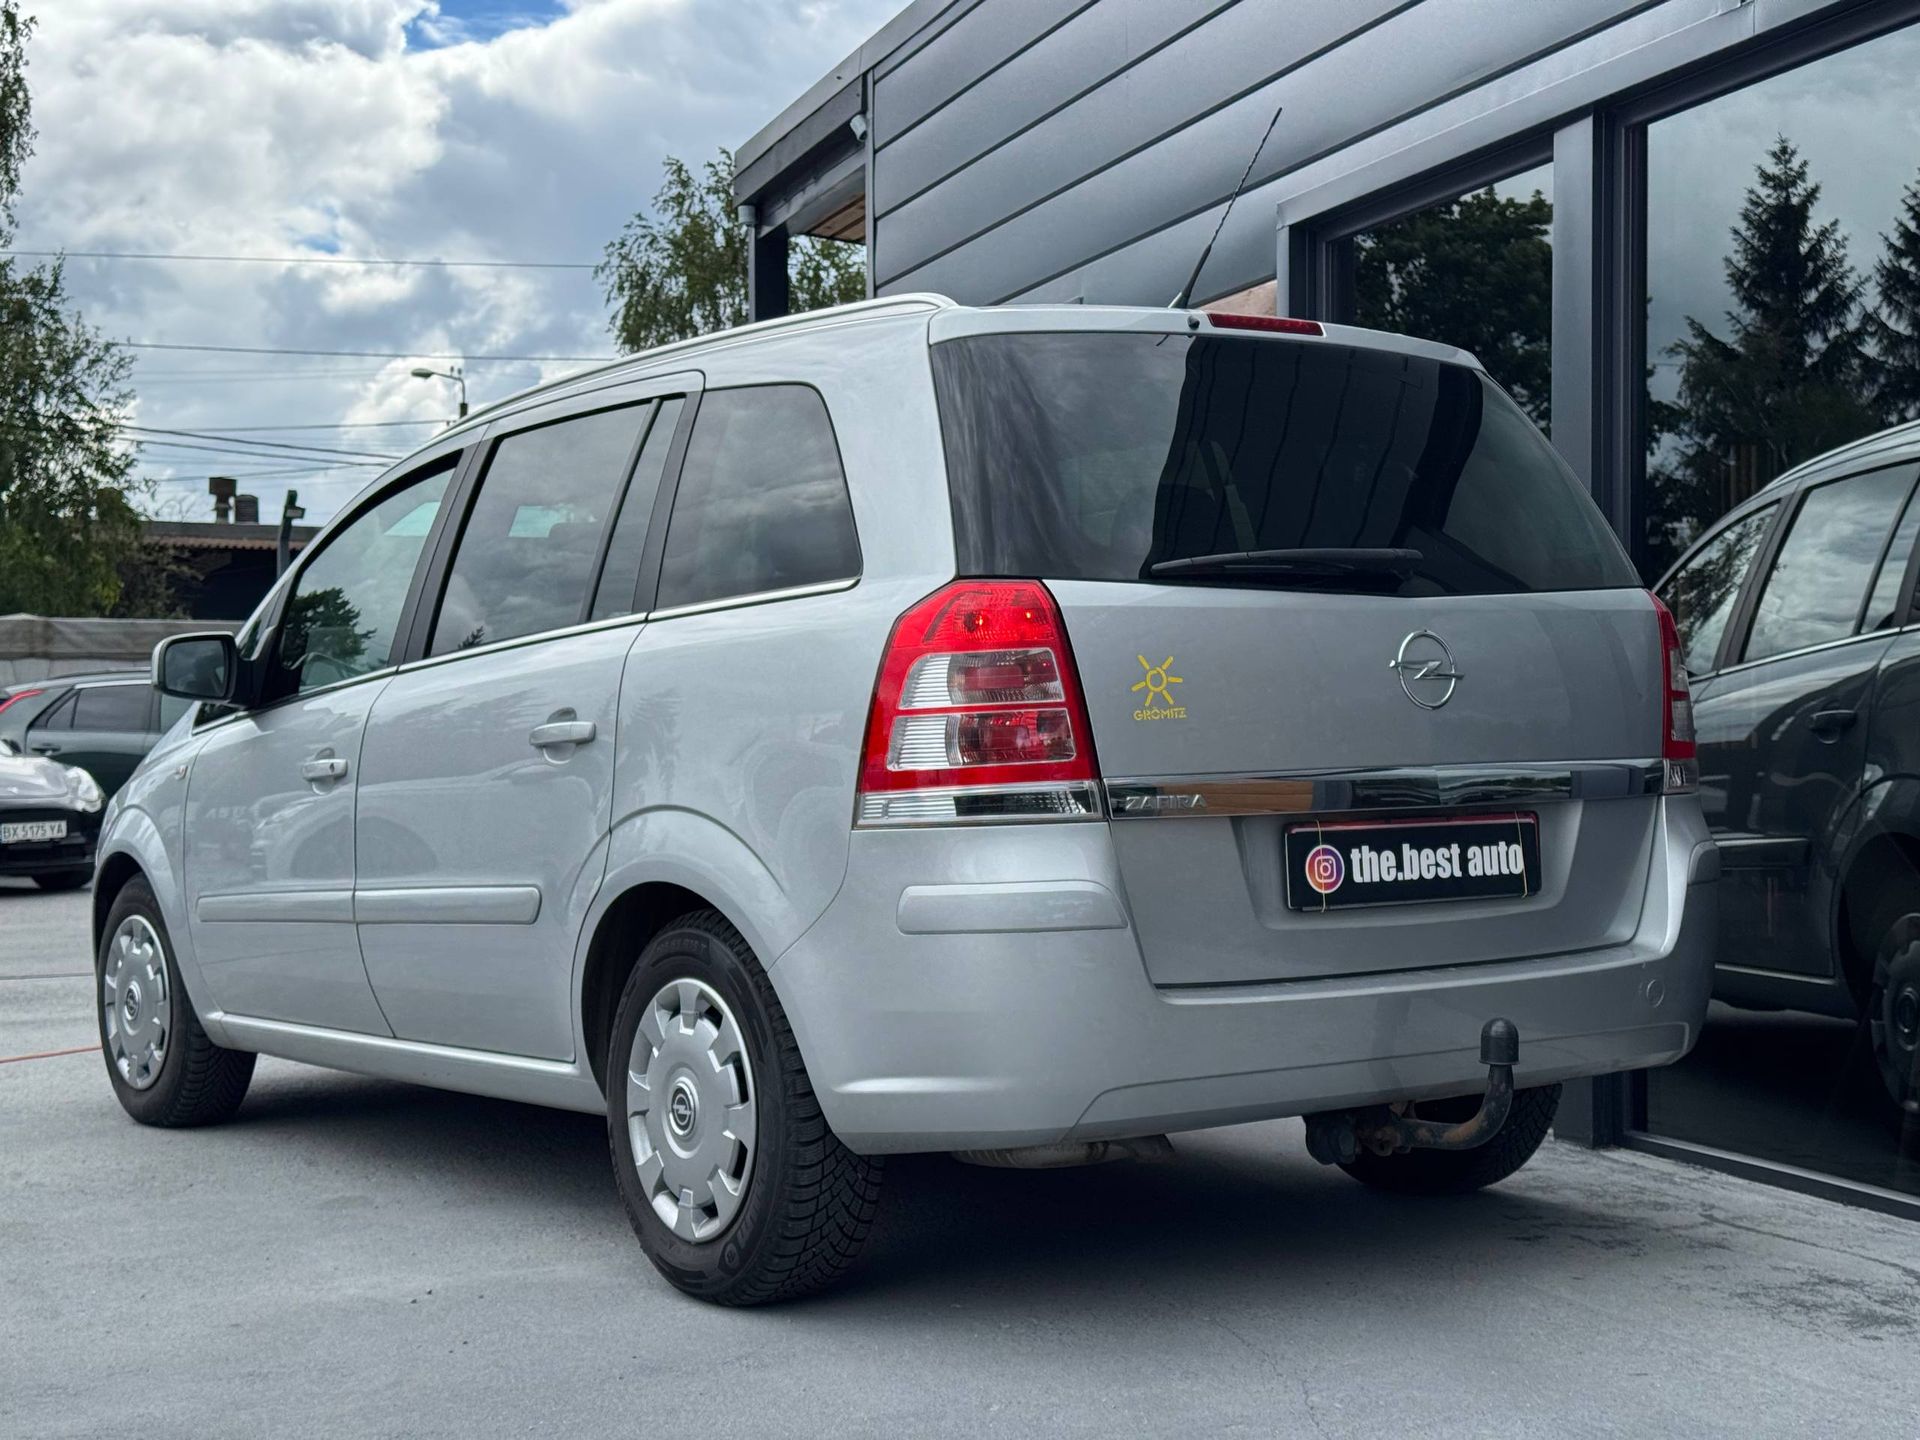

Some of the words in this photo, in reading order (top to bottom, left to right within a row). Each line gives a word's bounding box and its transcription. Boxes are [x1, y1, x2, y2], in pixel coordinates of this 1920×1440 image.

[1126, 794, 1207, 811] ZAFIRA
[50, 823, 63, 836] YA
[1350, 843, 1463, 884] the.best
[1467, 840, 1525, 878] auto
